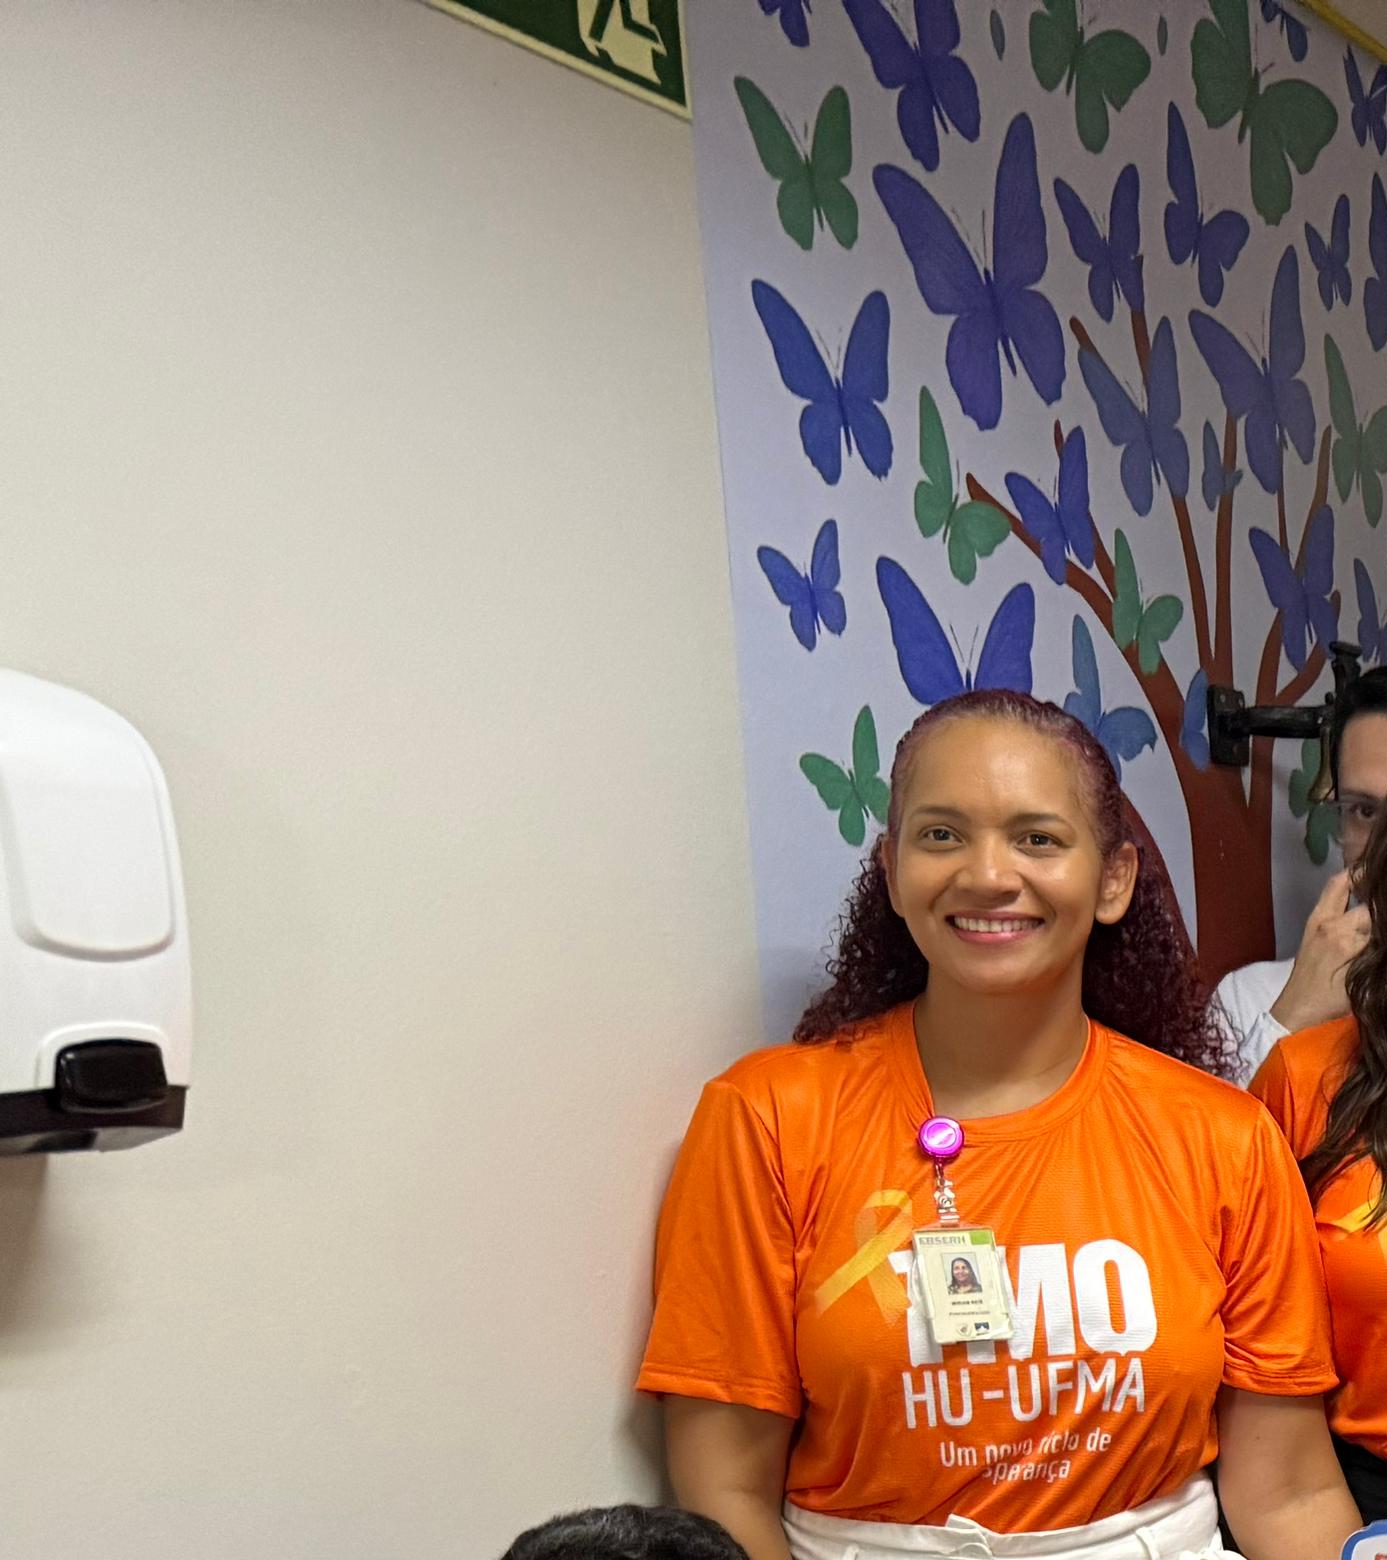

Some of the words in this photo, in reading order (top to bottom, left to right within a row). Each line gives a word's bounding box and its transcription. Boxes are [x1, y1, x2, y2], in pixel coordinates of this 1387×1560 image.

[902, 1358, 1145, 1429] HU-UFMA
[940, 1441, 977, 1467] Um
[985, 1438, 1033, 1465] novo
[1087, 1427, 1112, 1452] de
